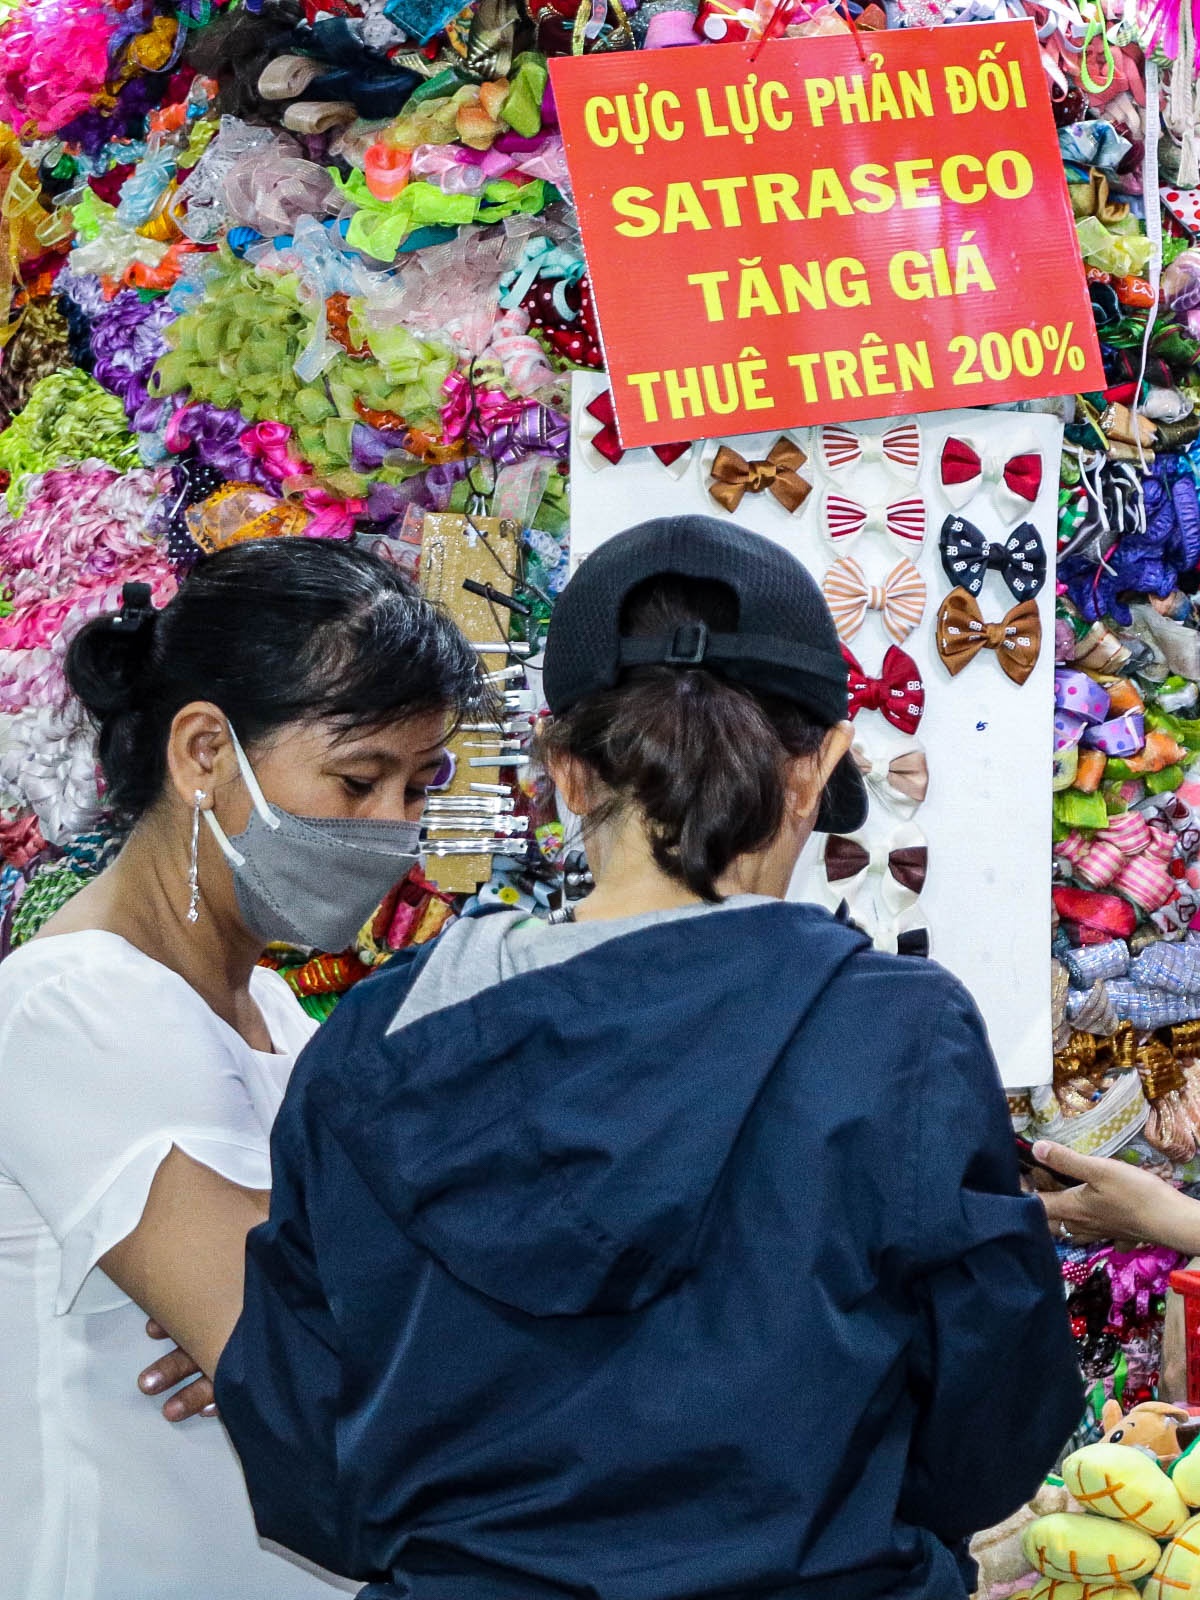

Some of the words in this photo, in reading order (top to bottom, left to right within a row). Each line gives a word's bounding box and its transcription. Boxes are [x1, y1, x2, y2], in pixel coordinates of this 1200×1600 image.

[584, 83, 685, 154] CỰC
[697, 73, 793, 144] LỰC
[805, 53, 934, 127] PHẢN
[945, 41, 1027, 114] ĐỐI
[612, 150, 1034, 238] SATRASECO
[688, 256, 871, 322] TĂNG
[889, 230, 996, 300] GIÁ
[627, 347, 776, 423] THUÊ
[788, 333, 934, 404] TRÊN
[947, 321, 1086, 386] 200%
